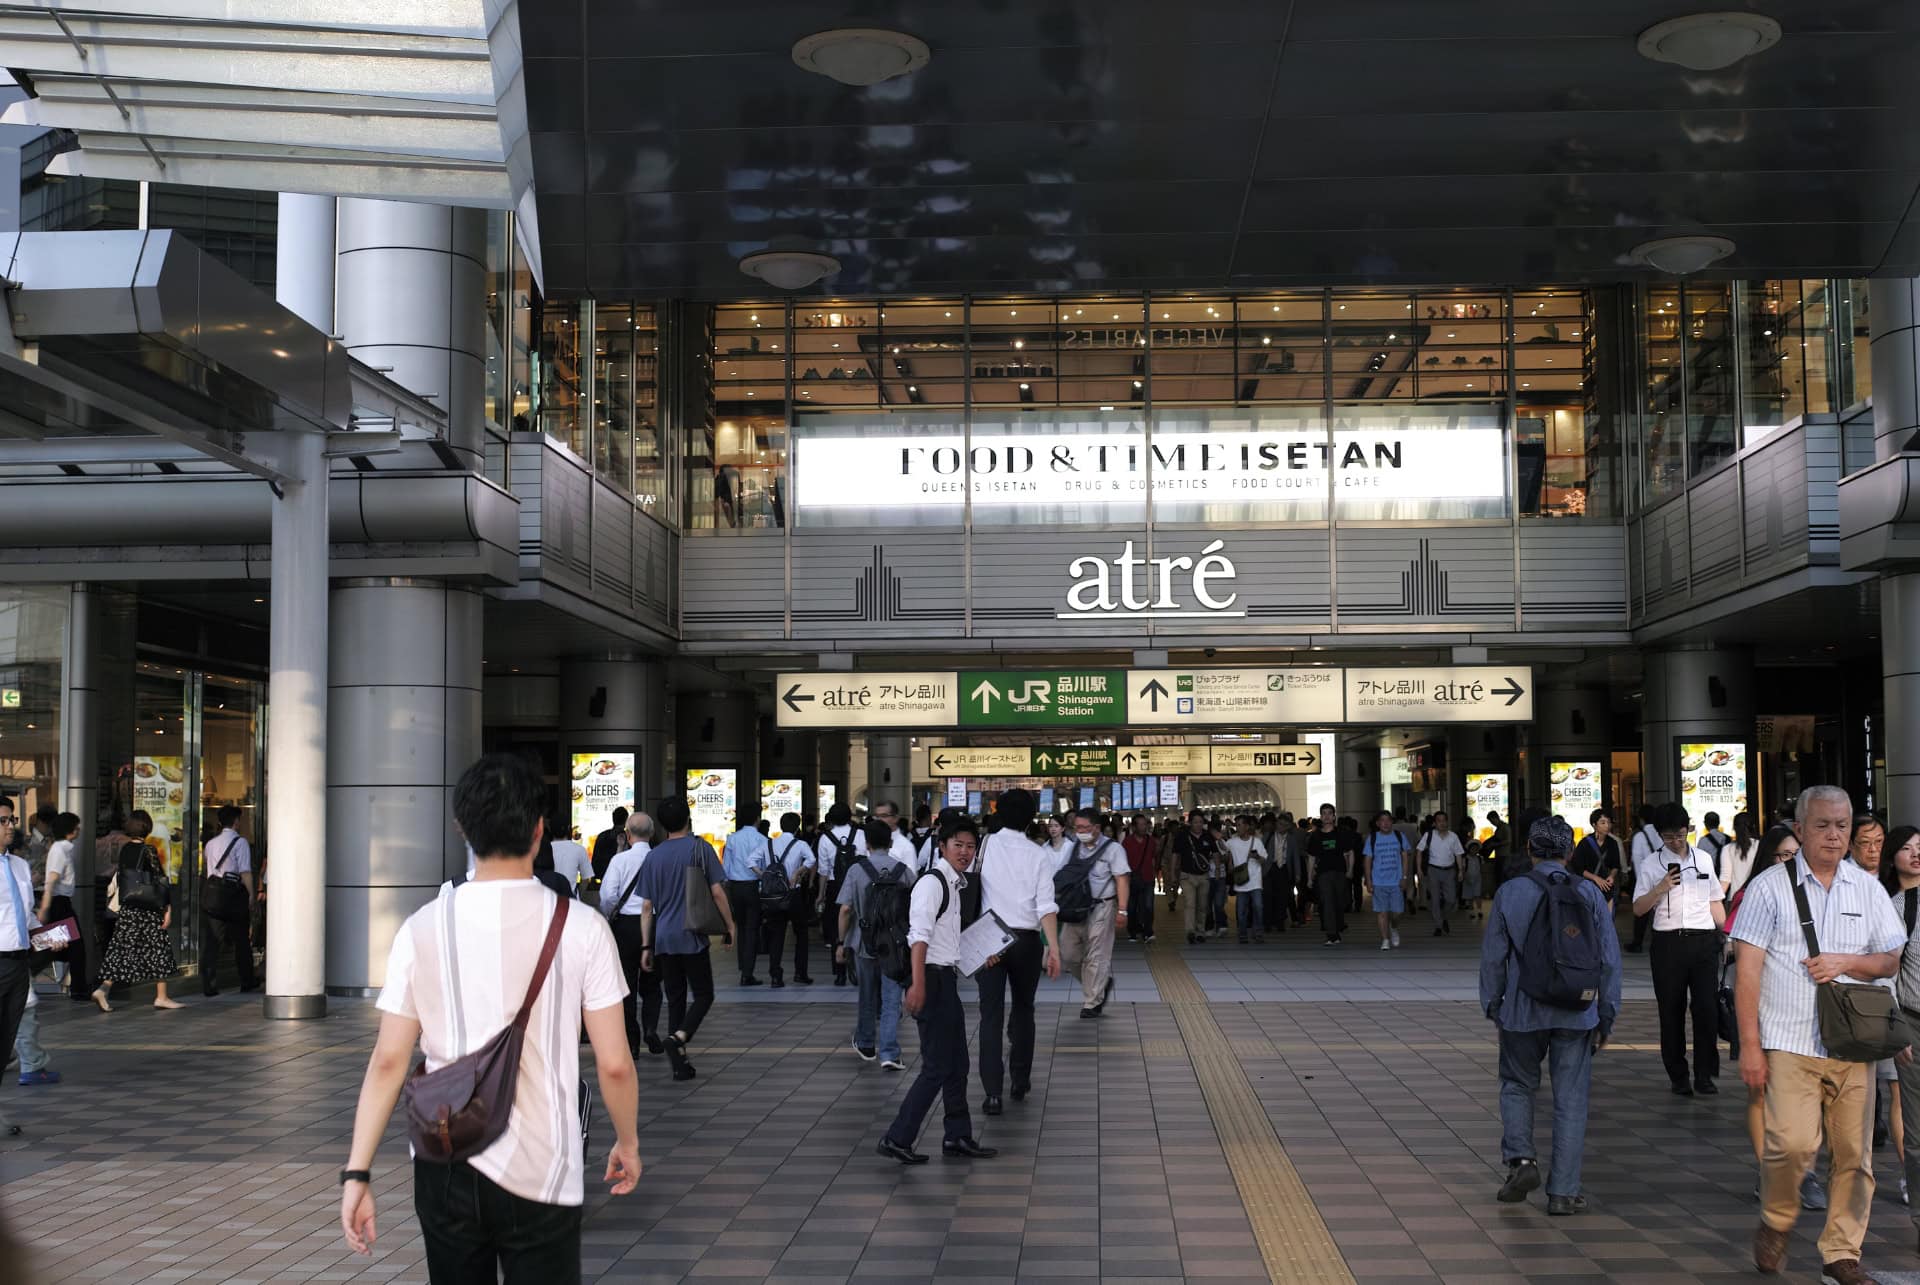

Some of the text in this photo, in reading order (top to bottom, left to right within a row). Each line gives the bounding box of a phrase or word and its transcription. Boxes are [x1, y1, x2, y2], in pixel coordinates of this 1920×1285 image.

[898, 441, 1402, 475] FOOD & TIME ISETAN
[921, 482, 981, 493] QUEENS
[988, 481, 1037, 492] ISETAN
[1065, 480, 1102, 490] DRUG
[1111, 480, 1120, 490] &
[1232, 478, 1268, 489] FOOD
[1276, 478, 1320, 488] COURT
[1344, 476, 1379, 487] CAFE
[1066, 539, 1237, 611] atré
[1057, 676, 1107, 693] 品川駅
[1196, 674, 1240, 684] びゅうプラザ
[879, 684, 945, 699] アトレ品川
[1007, 680, 1051, 704] JR
[1357, 680, 1425, 695] アトレ品川
[1433, 680, 1484, 701] atré
[822, 685, 872, 706] atré
[1057, 695, 1114, 706] Shinagawa
[1377, 697, 1425, 707] Shinagawa
[879, 702, 945, 711] atre Shinagawa
[1057, 706, 1094, 716] Station
[1055, 752, 1078, 766] JR
[1216, 753, 1252, 761] アトレ品川
[1698, 775, 1734, 788] CHEERS
[585, 784, 619, 797] CHEERS
[1564, 787, 1592, 797] CHEERS
[697, 793, 724, 803] CHEERS
[770, 799, 792, 808] CHEERS
[1477, 794, 1500, 802] CHEERS
